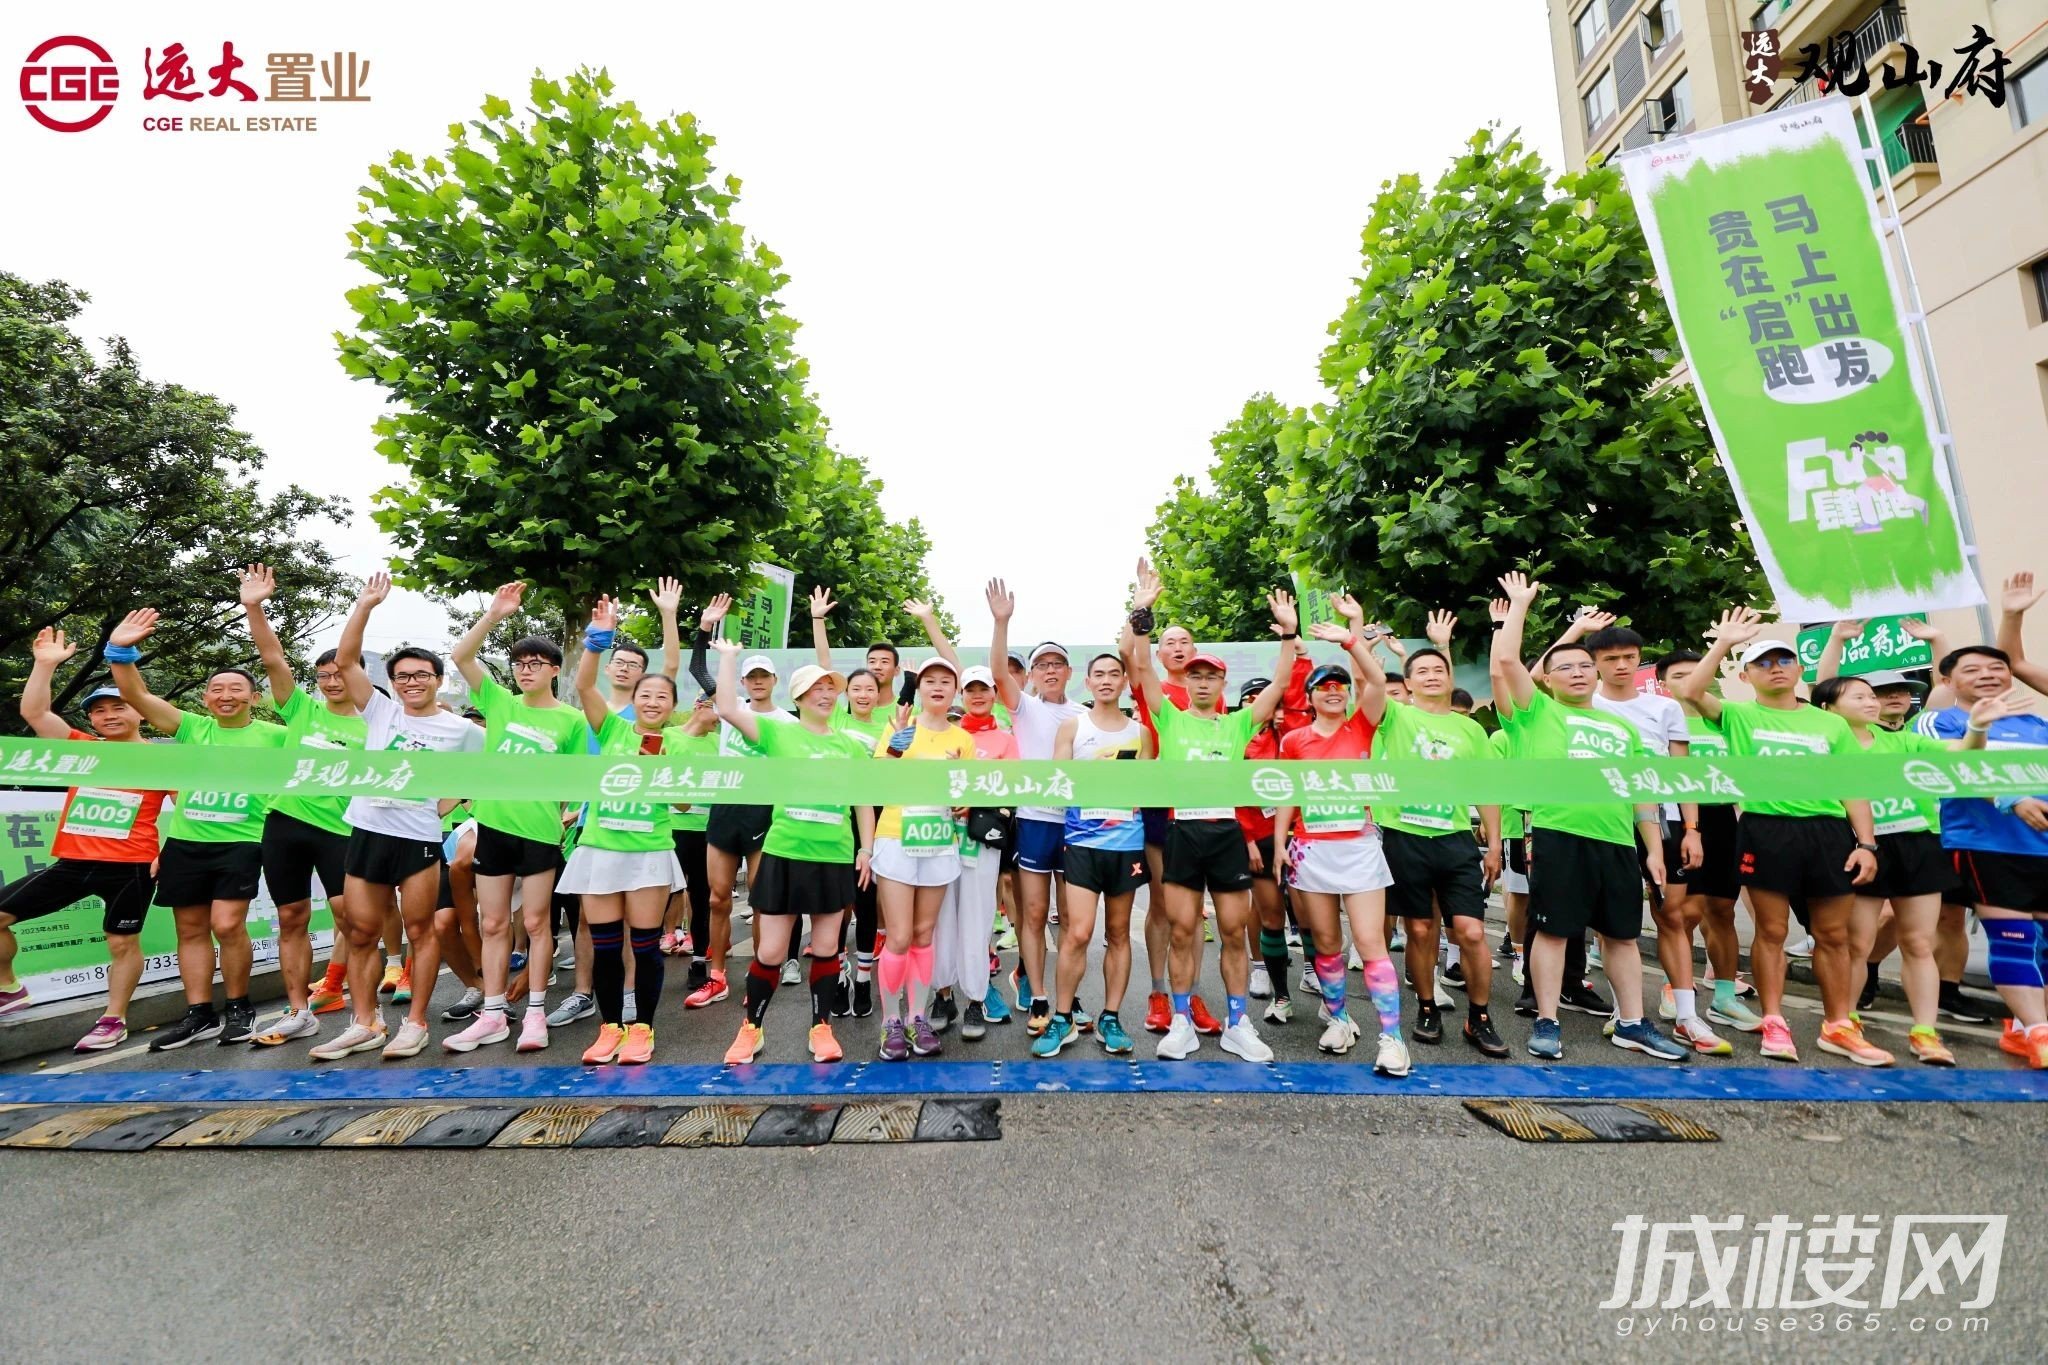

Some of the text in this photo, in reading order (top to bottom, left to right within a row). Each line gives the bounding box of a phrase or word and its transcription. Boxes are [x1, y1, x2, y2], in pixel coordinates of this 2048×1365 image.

[1764, 194, 1878, 387] 马上出发
[1786, 437, 1908, 524] Fun
[1840, 623, 1926, 666] 品药业
[1571, 730, 1627, 758] A062
[3, 749, 100, 775] 远大置业
[649, 766, 744, 789] 远大置业
[1301, 769, 1400, 792] 远大置业
[188, 790, 248, 809] A016
[69, 802, 132, 824] A009
[905, 822, 951, 841] A020
[64, 971, 91, 985] 0851
